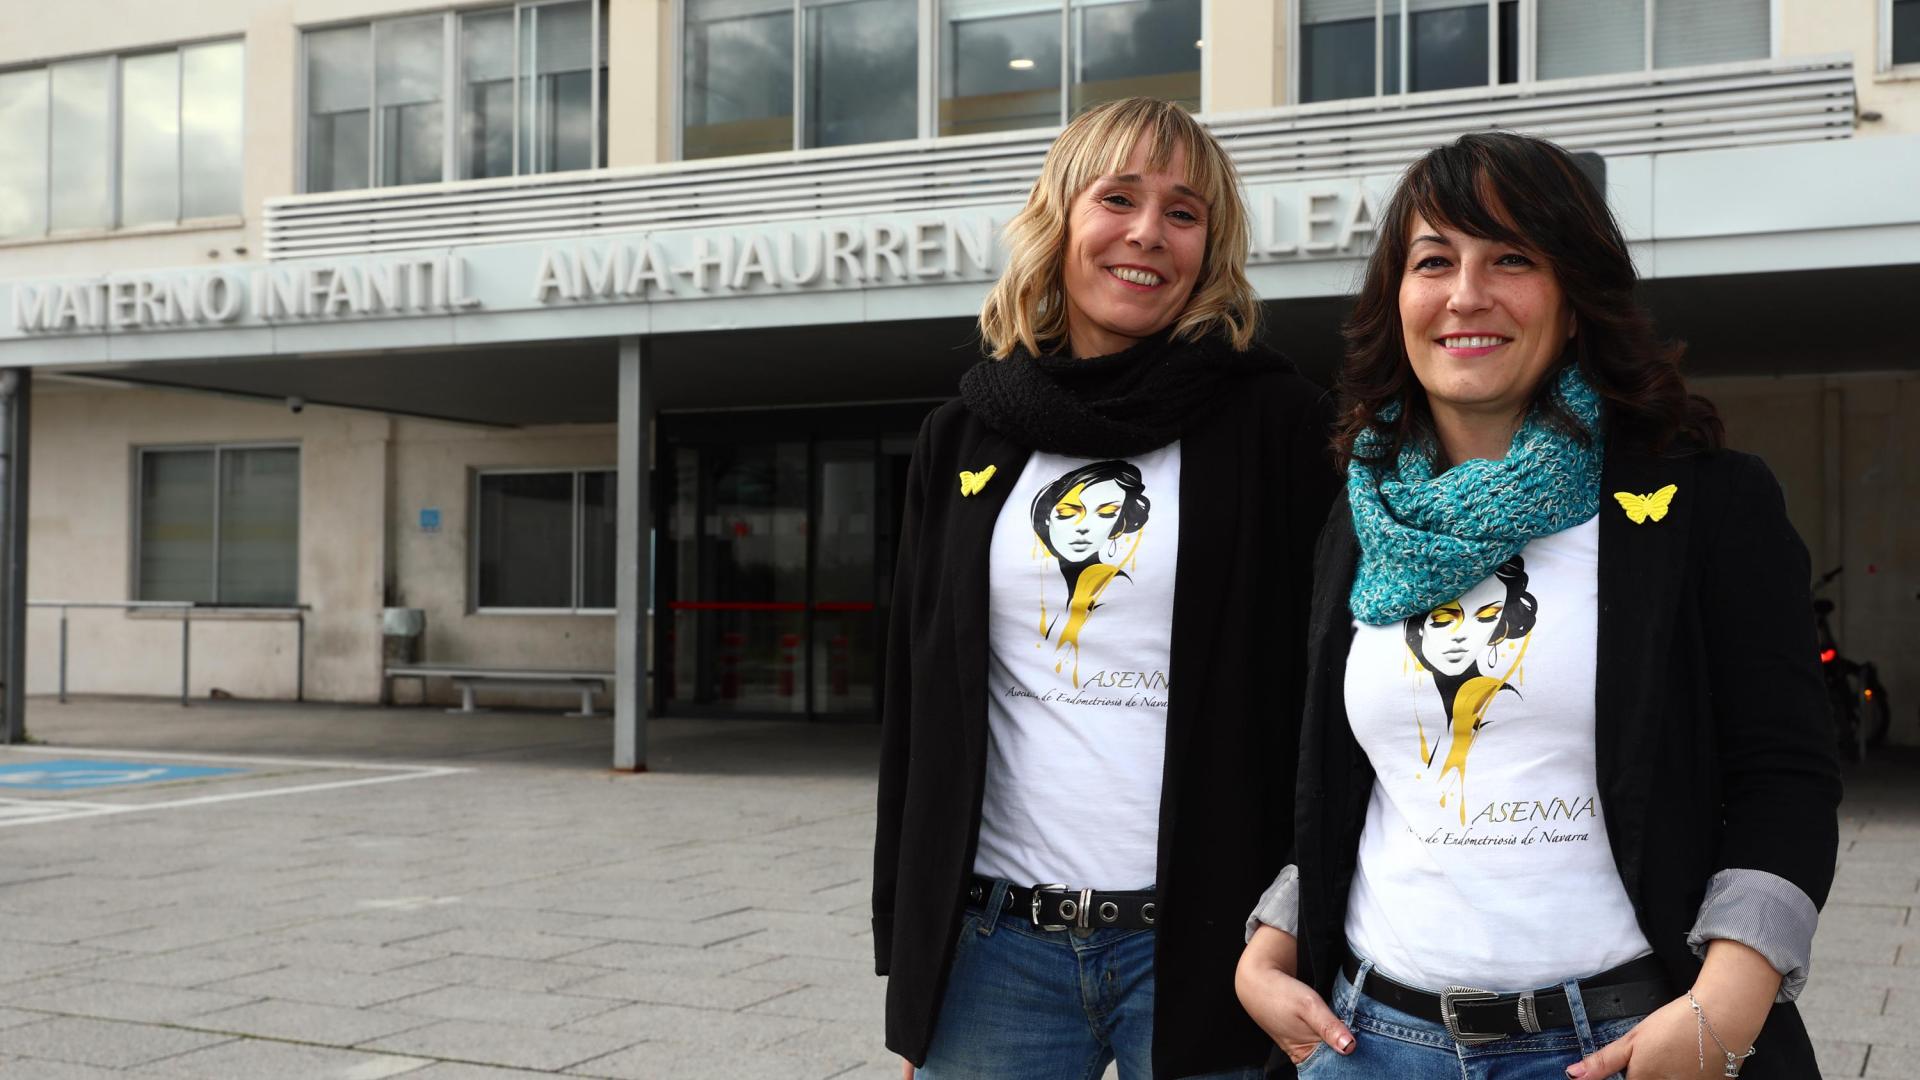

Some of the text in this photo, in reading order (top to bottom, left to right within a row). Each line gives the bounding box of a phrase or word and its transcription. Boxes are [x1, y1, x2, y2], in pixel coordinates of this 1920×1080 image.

[13, 178, 1378, 334] MATERNO INFANTIL AMA-HAURREN LEA
[1083, 670, 1169, 690] ASENN
[1041, 688, 1056, 702] de
[1056, 690, 1122, 708] Endometriosis
[1125, 692, 1140, 708] de
[1140, 696, 1168, 708] Nava
[1471, 797, 1596, 825] ASENNA
[1424, 827, 1443, 844] de
[1443, 827, 1517, 846] Endometriosis
[1520, 826, 1538, 846] de
[1539, 829, 1589, 844] Navarra
